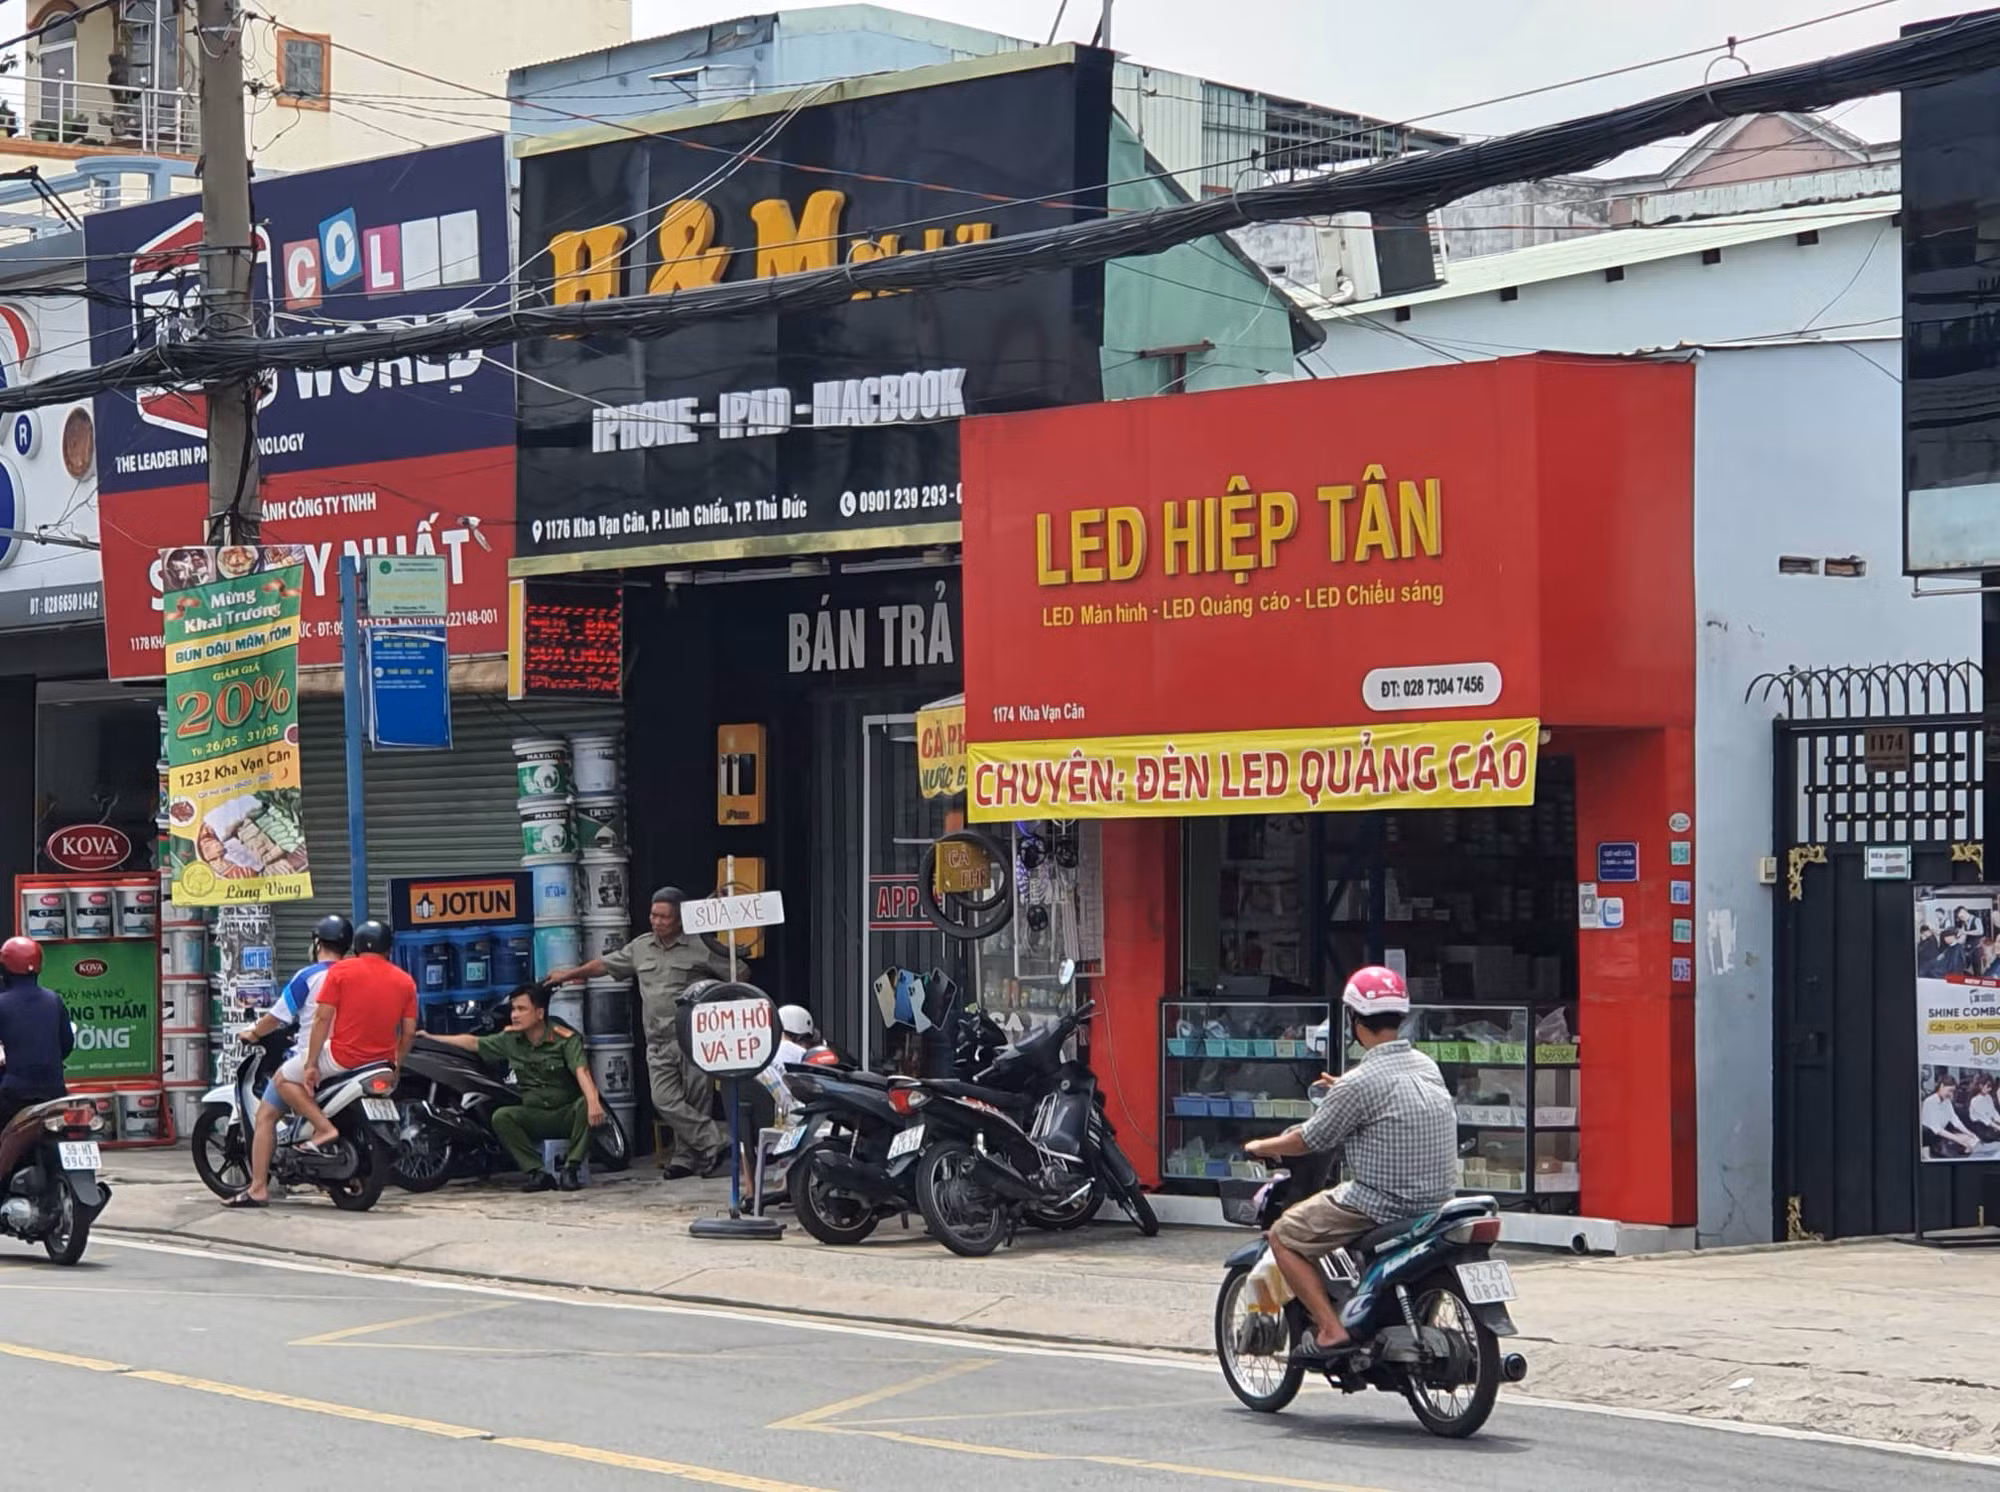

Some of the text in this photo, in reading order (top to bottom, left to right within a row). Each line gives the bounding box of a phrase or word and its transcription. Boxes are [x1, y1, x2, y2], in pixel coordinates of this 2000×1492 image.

[651, 199, 733, 294] &
[593, 398, 698, 453] IPHONE
[720, 388, 791, 439] IPAD
[813, 368, 966, 429] MACBOOK
[116, 456, 136, 473] THE
[138, 449, 178, 470] LEADER
[180, 449, 192, 465] IN
[257, 433, 304, 456] NOLOGY
[261, 492, 376, 522] ÁNH CÔNG TY TNHH
[860, 489, 890, 512] 0901
[894, 487, 918, 509] 239
[545, 518, 570, 539] 1176
[573, 517, 595, 538] Kha
[599, 515, 620, 539] Vạn
[623, 512, 649, 534] Cân,
[652, 510, 662, 530] P.
[664, 507, 690, 529] Linh
[735, 501, 752, 523] TP.
[755, 495, 777, 520] Thủ
[782, 494, 807, 519] Đức
[1036, 463, 1442, 587] LED HIỆP TÂN
[211, 590, 256, 609] Mừng
[1042, 606, 1074, 627] LED
[1080, 603, 1113, 625] Màn
[1116, 603, 1148, 623] hình
[1162, 598, 1195, 620] LED
[1200, 594, 1253, 618] Quảng
[1260, 591, 1290, 611] cáo
[1305, 586, 1340, 609] LED
[1346, 579, 1394, 606] Chiếu
[1401, 580, 1443, 606] sáng
[184, 613, 222, 634] Khai
[788, 580, 954, 673] BÁN TRẢ
[130, 638, 150, 651] 1178
[176, 646, 202, 663] BÚN
[269, 625, 291, 643] TÔM
[1381, 675, 1484, 698] ĐT: 028 7304 7456
[176, 669, 290, 739] 20%
[993, 702, 1084, 723] 1174 Kha Vạn Cân
[205, 736, 238, 754] 26/05
[247, 724, 279, 742] 31/05
[921, 720, 966, 759] CÀ PH
[1870, 734, 1904, 751] 1174
[180, 770, 210, 787] 1232
[214, 765, 238, 779] Kha
[241, 758, 263, 773] Vạn
[267, 750, 291, 765] Cân
[923, 763, 953, 790] NƯỚC
[975, 748, 1127, 807] CHUYÊN:
[1135, 743, 1210, 803] ĐÈN
[1219, 750, 1289, 800] LED
[1299, 730, 1438, 806] QUẢNG
[1448, 728, 1528, 791] CÁO
[62, 836, 118, 855] KOVA
[226, 881, 301, 902] Làng Vòng
[439, 889, 511, 917] JOTUN
[79, 963, 104, 972] KOVA
[99, 999, 147, 1020] THẤM
[1928, 1008, 1960, 1018] SHINE
[701, 1032, 761, 1063] VÁ ÉP
[1969, 1036, 2000, 1056] 10
